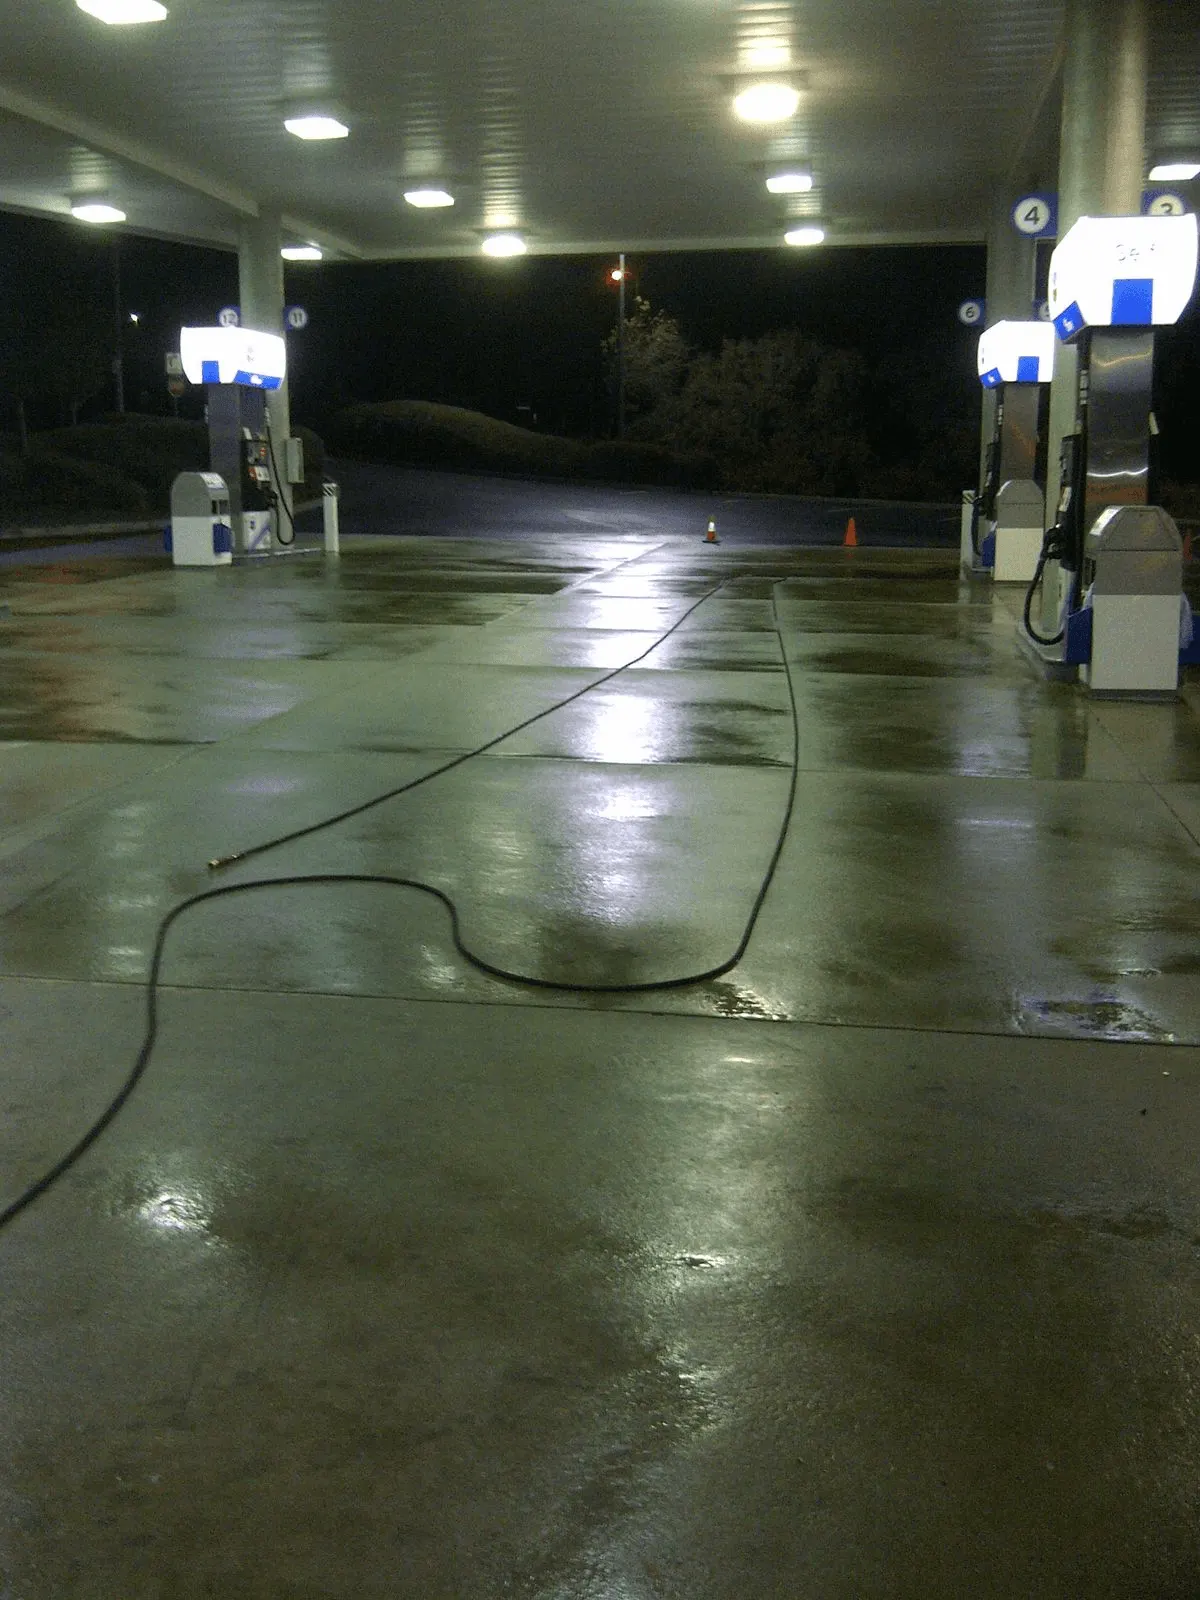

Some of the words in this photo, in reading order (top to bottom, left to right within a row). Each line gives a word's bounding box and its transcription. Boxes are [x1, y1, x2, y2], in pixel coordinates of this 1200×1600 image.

[1024, 206, 1040, 225] 4
[293, 312, 303, 323] 11
[965, 306, 975, 318] 6
